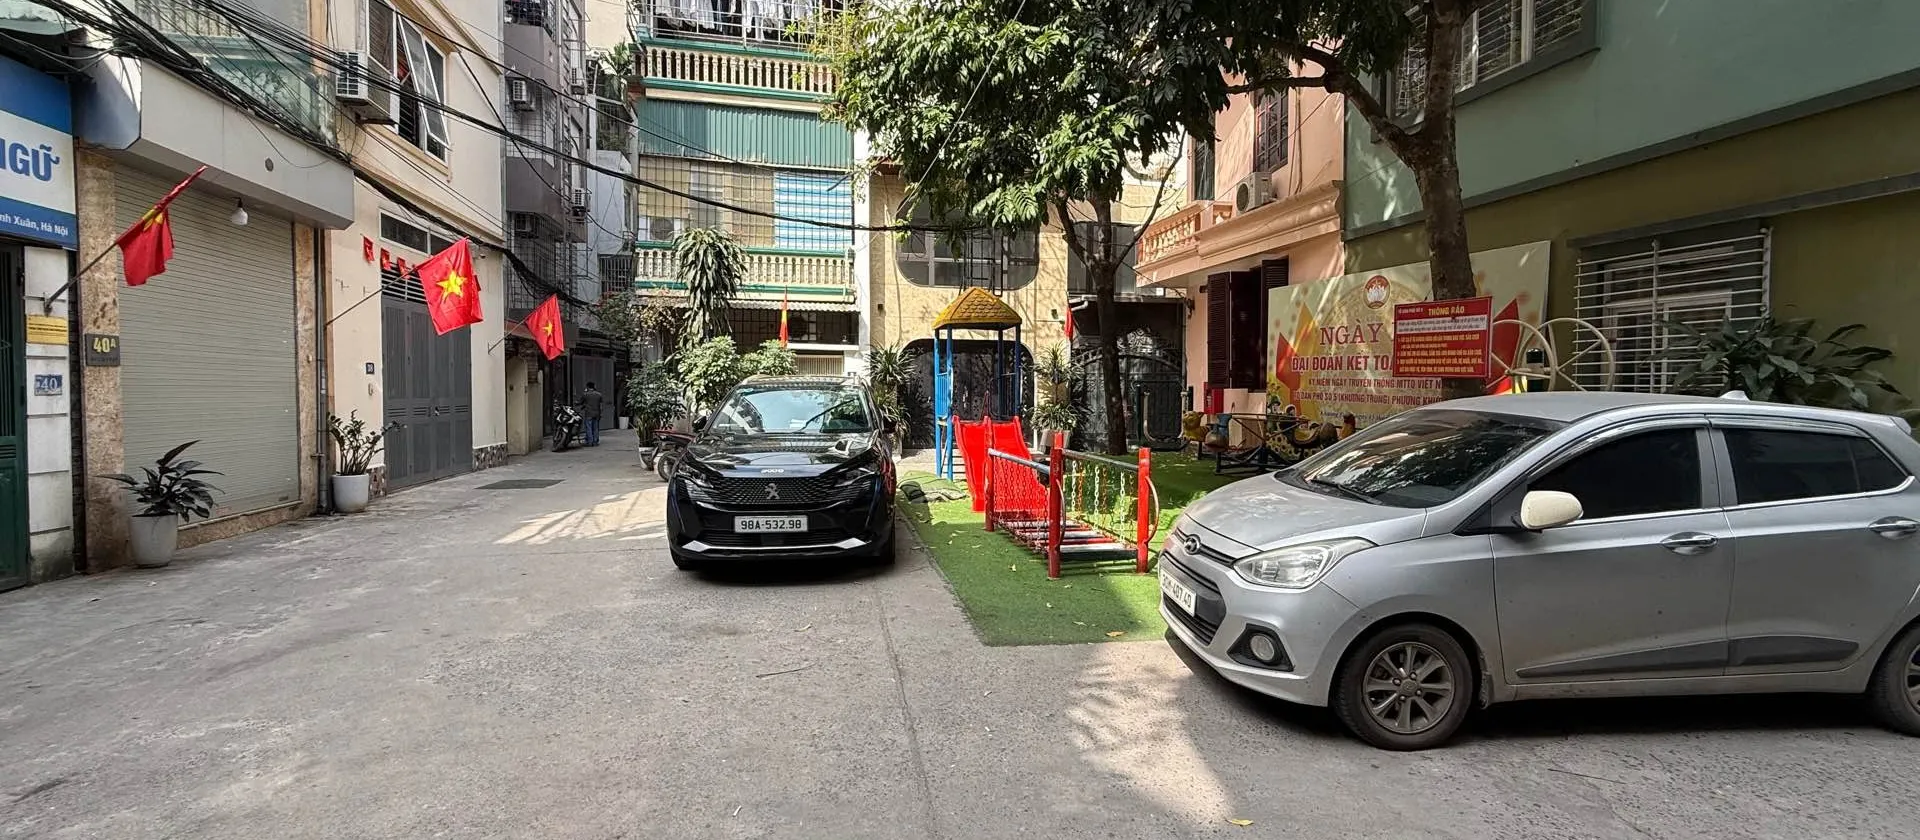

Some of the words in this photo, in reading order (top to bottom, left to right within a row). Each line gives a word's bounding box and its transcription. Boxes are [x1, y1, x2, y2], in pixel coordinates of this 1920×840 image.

[13, 215, 40, 231] Xuân,
[41, 221, 52, 233] Hà
[54, 224, 69, 238] Nội
[1320, 319, 1384, 346] NGÀY
[1292, 356, 1309, 374] ĐẠI
[1312, 353, 1343, 371] ĐOÀN
[1347, 351, 1369, 371] KẾT
[741, 519, 802, 530] 98A-532.98
